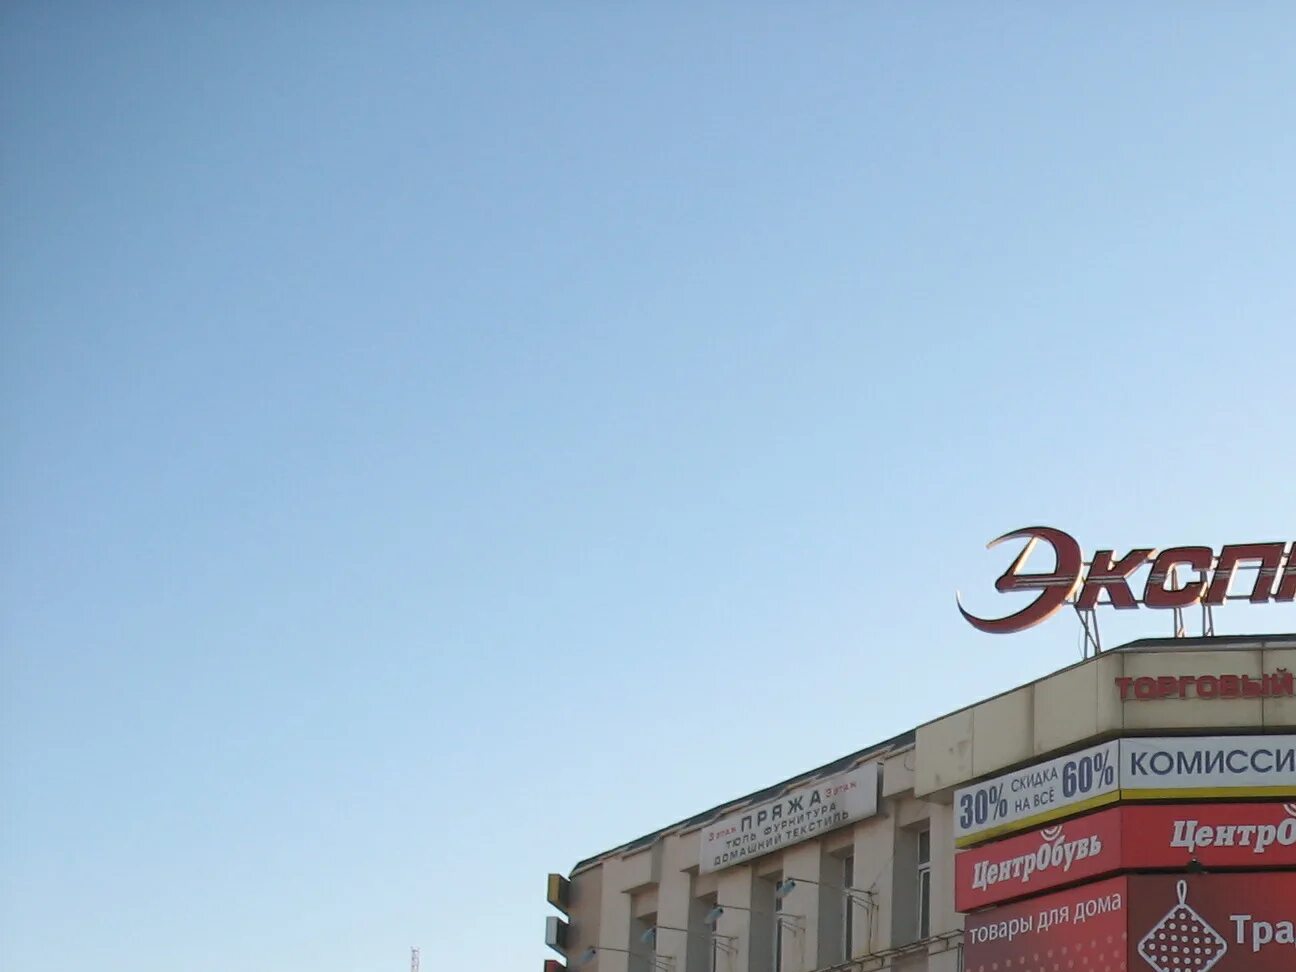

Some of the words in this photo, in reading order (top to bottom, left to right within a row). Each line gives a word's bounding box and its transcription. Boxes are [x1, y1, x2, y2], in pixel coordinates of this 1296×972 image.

[1115, 668, 1293, 700] ТОРГОВЫЙ
[1011, 766, 1058, 792] СКИДКА
[1062, 748, 1114, 797] 60%
[726, 832, 757, 849] ТЮЛЬ
[763, 801, 837, 836] ФУРНИТУРА
[741, 789, 822, 833] ПРЯЖА
[960, 783, 1008, 829] 30%
[1015, 796, 1031, 812] НА
[713, 833, 783, 867] ДОМАШНИЙ
[785, 810, 850, 840] ТЕКСТИЛЬ
[972, 834, 1102, 891] ЦентрОбувь
[969, 915, 1034, 945] товары
[1037, 906, 1070, 933] для
[1073, 892, 1122, 923] дома
